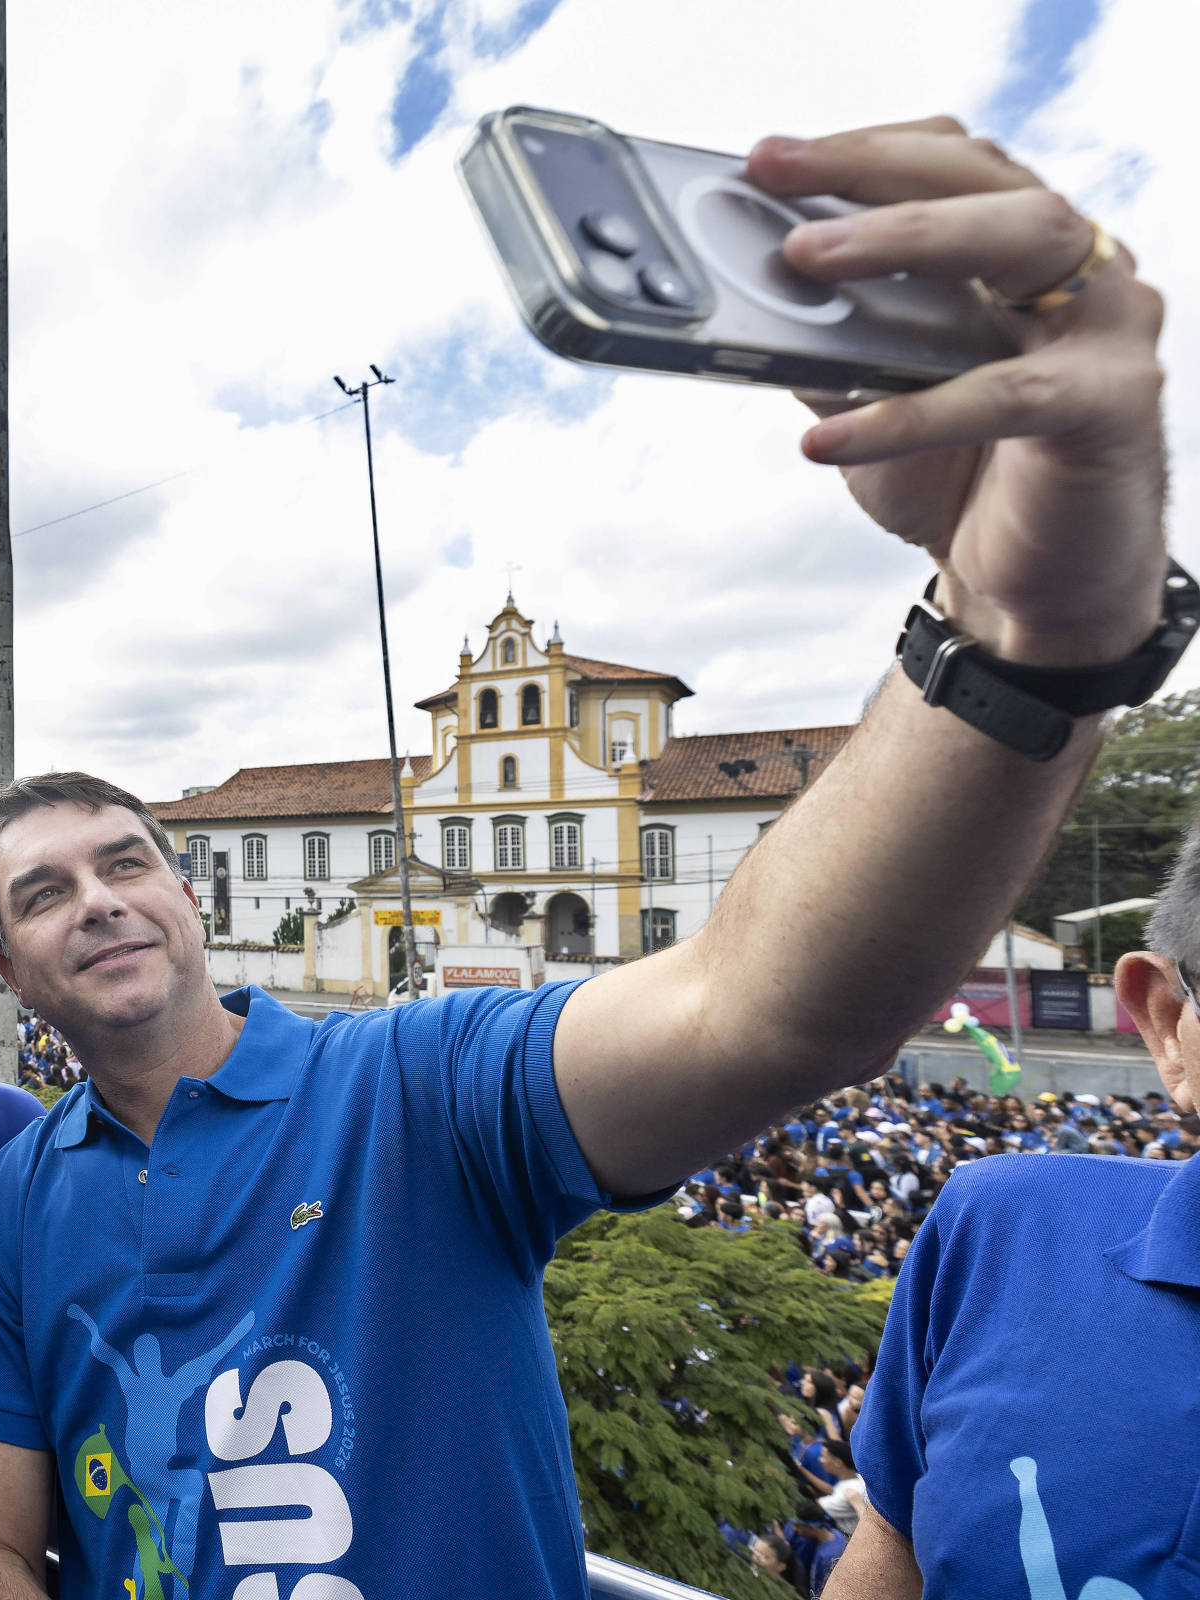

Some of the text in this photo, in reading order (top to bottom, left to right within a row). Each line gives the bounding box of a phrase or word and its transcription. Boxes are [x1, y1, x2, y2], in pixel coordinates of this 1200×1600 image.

[243, 1334, 356, 1470] MARCH FOR JESUS 2026
